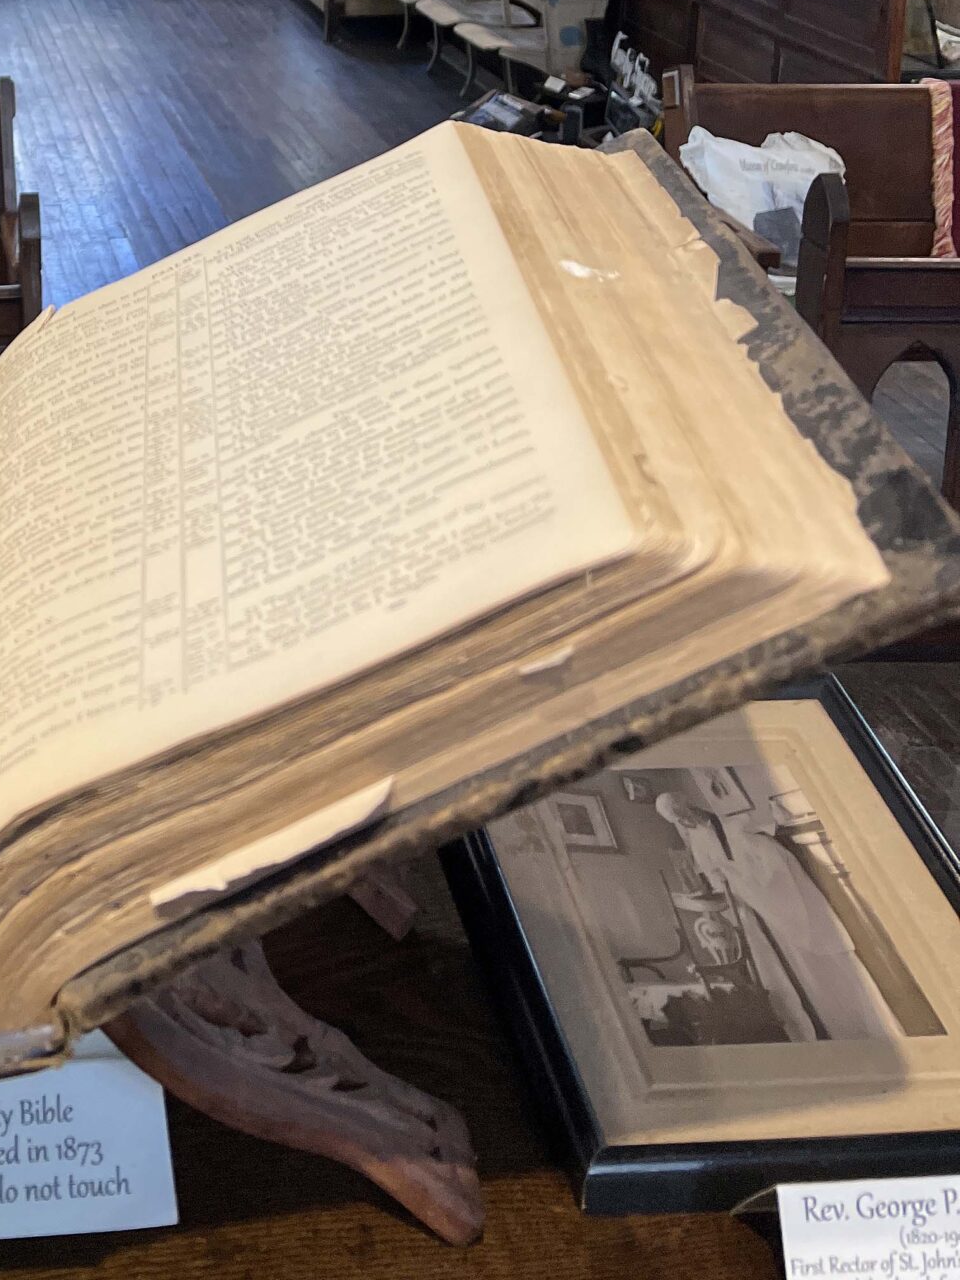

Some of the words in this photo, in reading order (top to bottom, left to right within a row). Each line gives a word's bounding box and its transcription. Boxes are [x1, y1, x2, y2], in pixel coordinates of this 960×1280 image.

[20, 1094, 74, 1126] Bible
[27, 1138, 49, 1163] in
[56, 1137, 104, 1167] 1873
[24, 1175, 62, 1202] not
[69, 1166, 131, 1198] touch
[803, 1196, 850, 1222] Rev.
[856, 1192, 937, 1227] George
[791, 1257, 825, 1276] First
[829, 1256, 878, 1274] Rector
[881, 1250, 897, 1277] of
